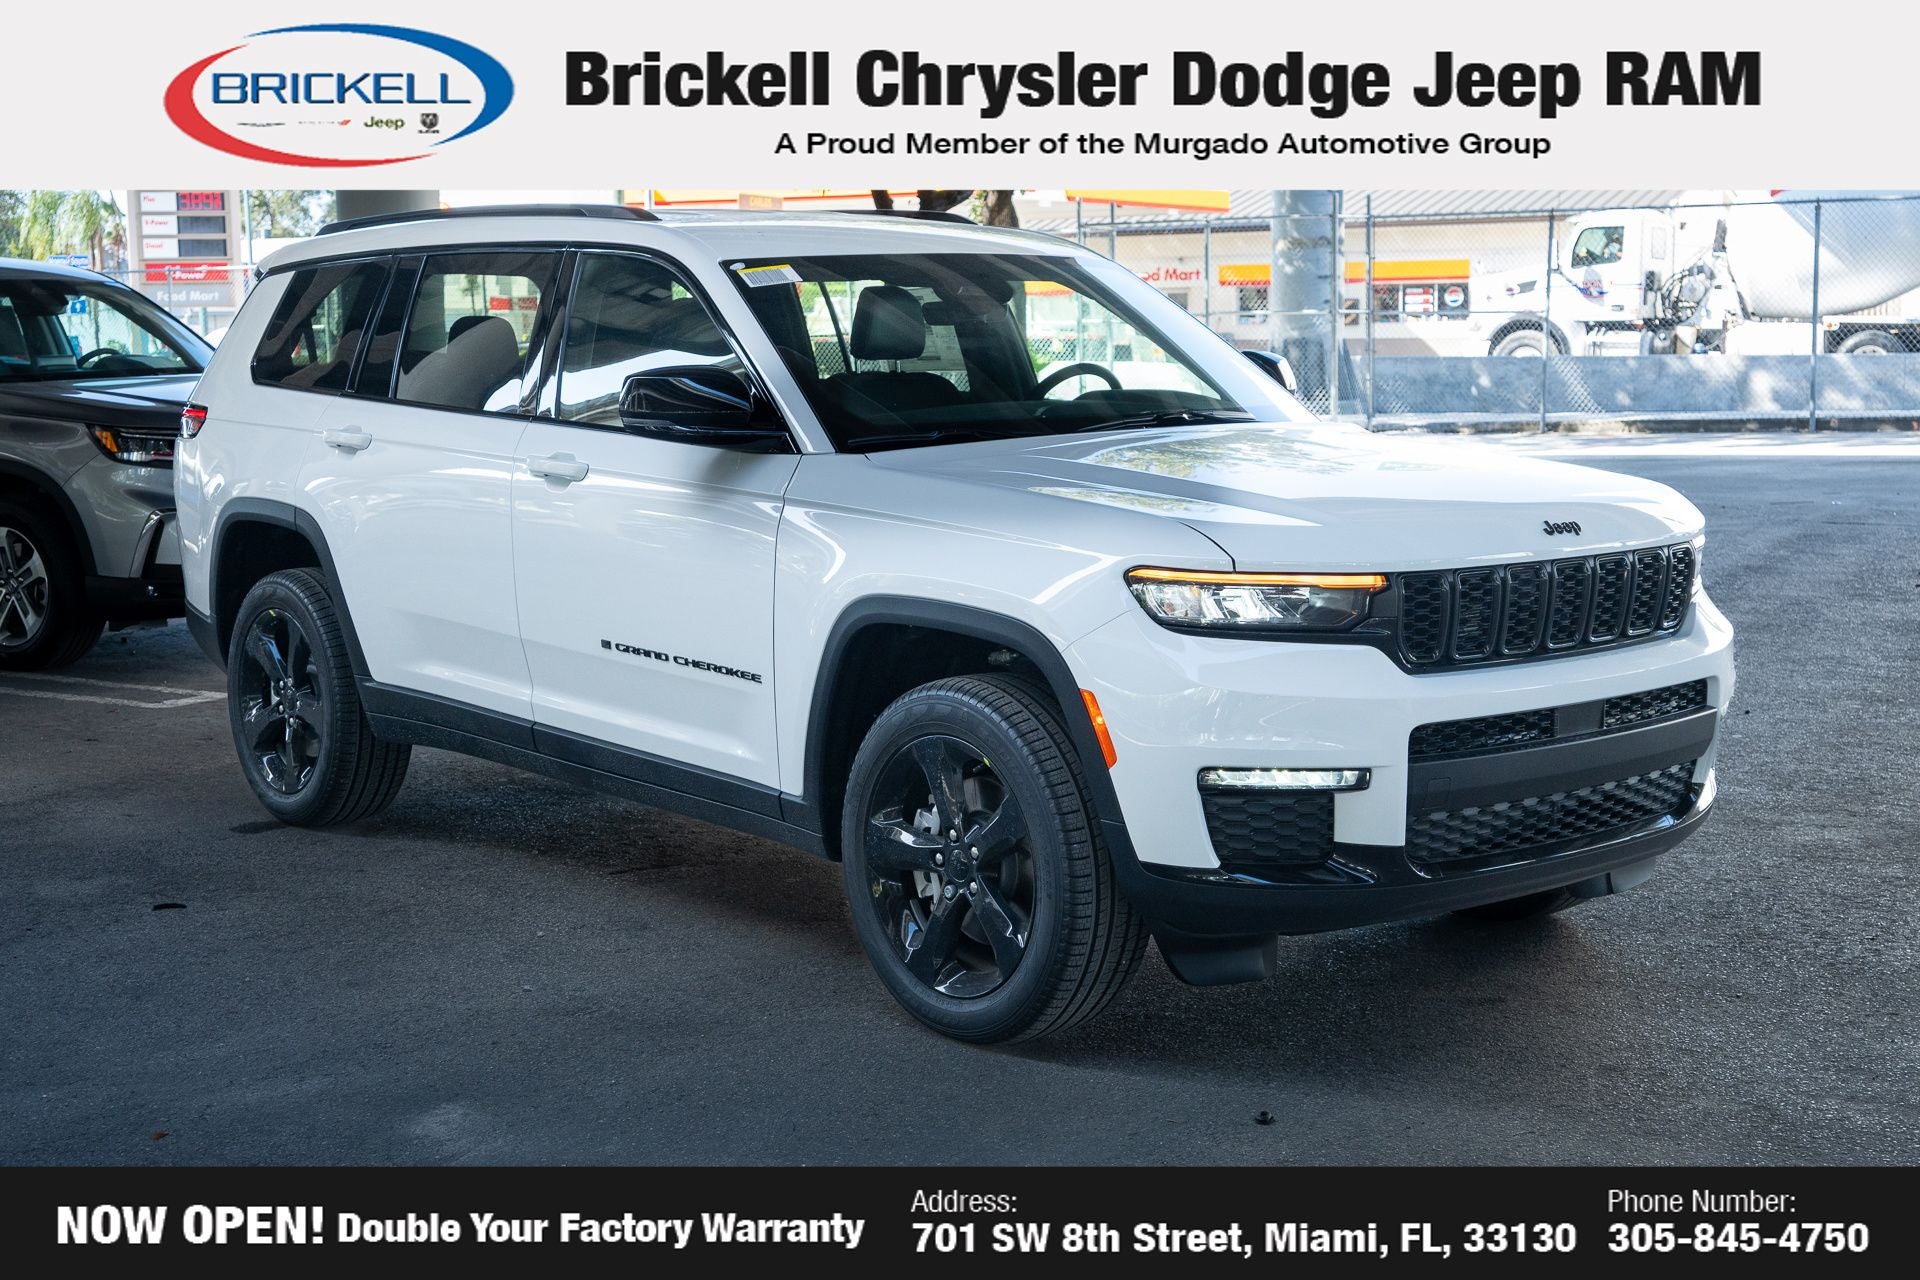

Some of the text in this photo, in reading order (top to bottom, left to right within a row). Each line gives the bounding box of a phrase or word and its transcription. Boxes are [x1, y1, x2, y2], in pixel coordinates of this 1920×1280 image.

[1164, 268, 1200, 281] Mart
[189, 290, 219, 301] Mart
[1543, 520, 1582, 536] Jeep
[615, 643, 762, 684] GRAND CHEROKEE
